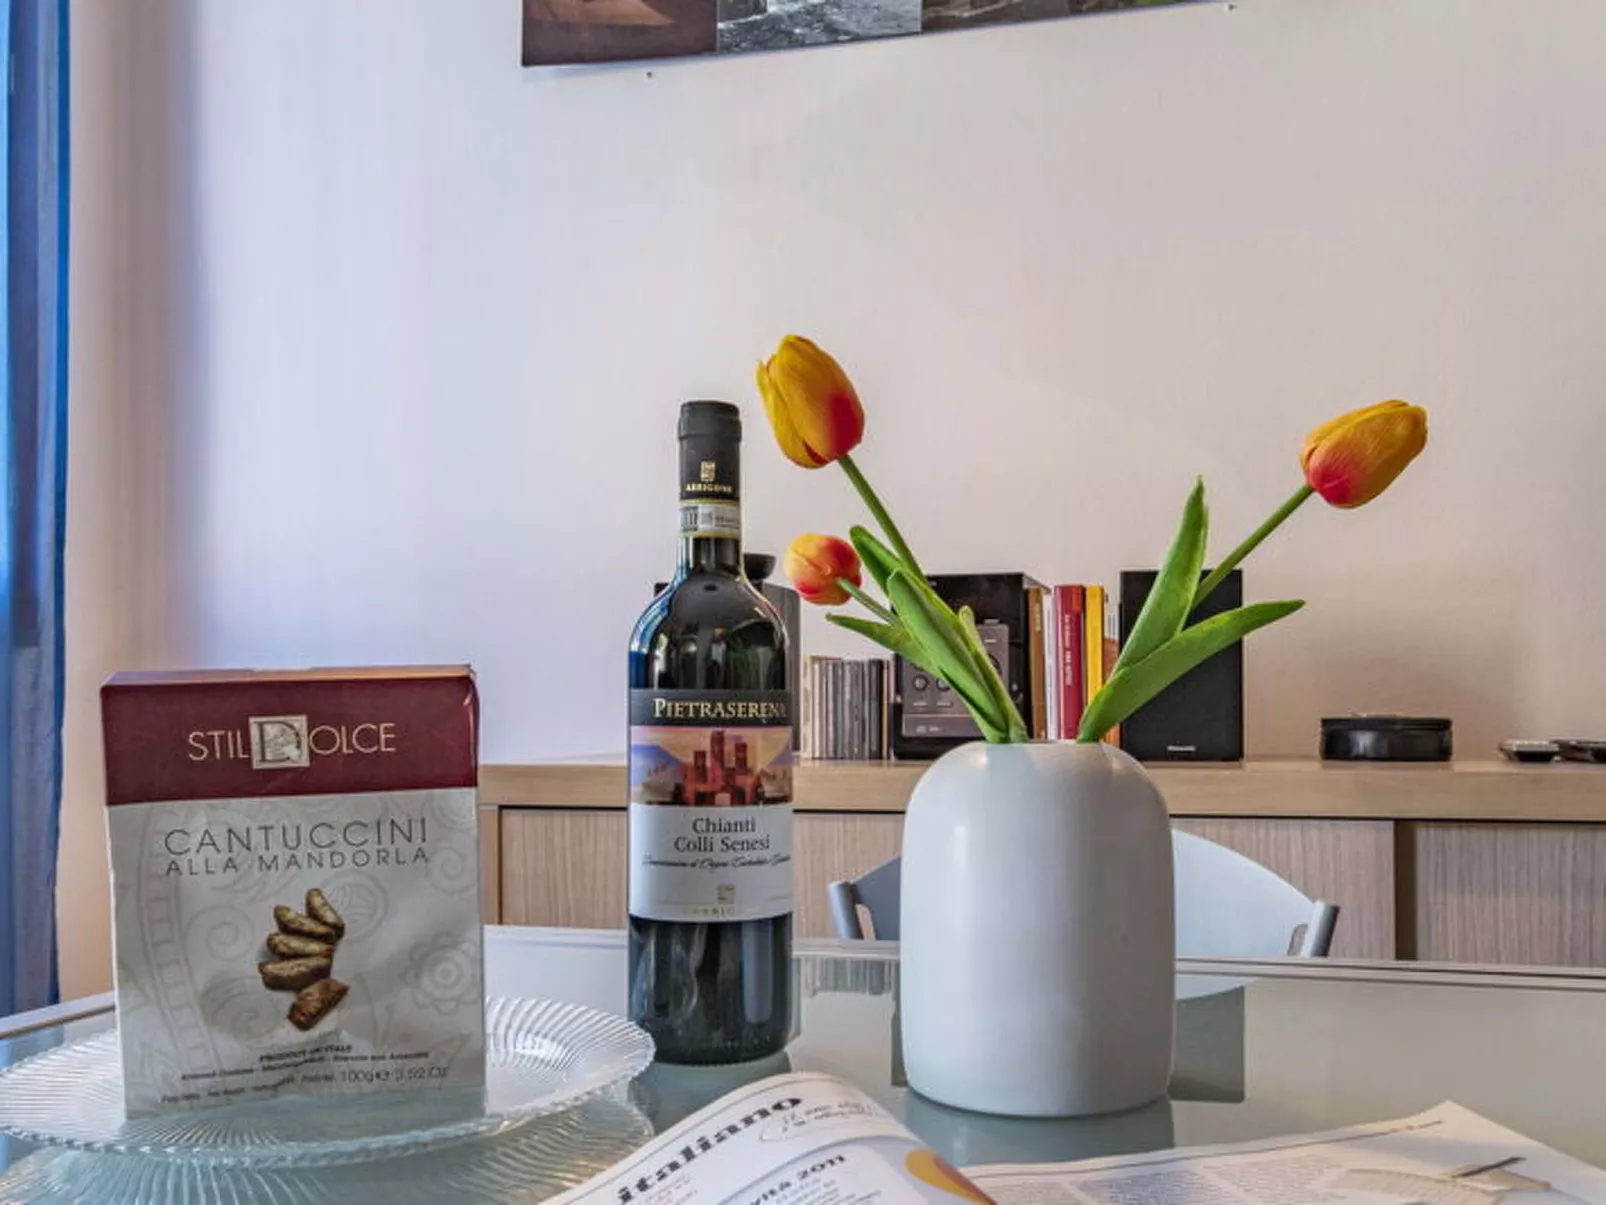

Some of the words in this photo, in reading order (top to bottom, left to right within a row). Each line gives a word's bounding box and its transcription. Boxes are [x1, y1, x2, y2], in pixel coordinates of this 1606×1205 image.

[164, 818, 427, 856] CANTUCCINI
[692, 816, 756, 834] Chianti
[674, 836, 714, 852] Colli
[720, 834, 770, 852] Senesi
[165, 857, 239, 877] ALLA
[258, 847, 429, 872] MANDORLA
[618, 1098, 802, 1204] italiano
